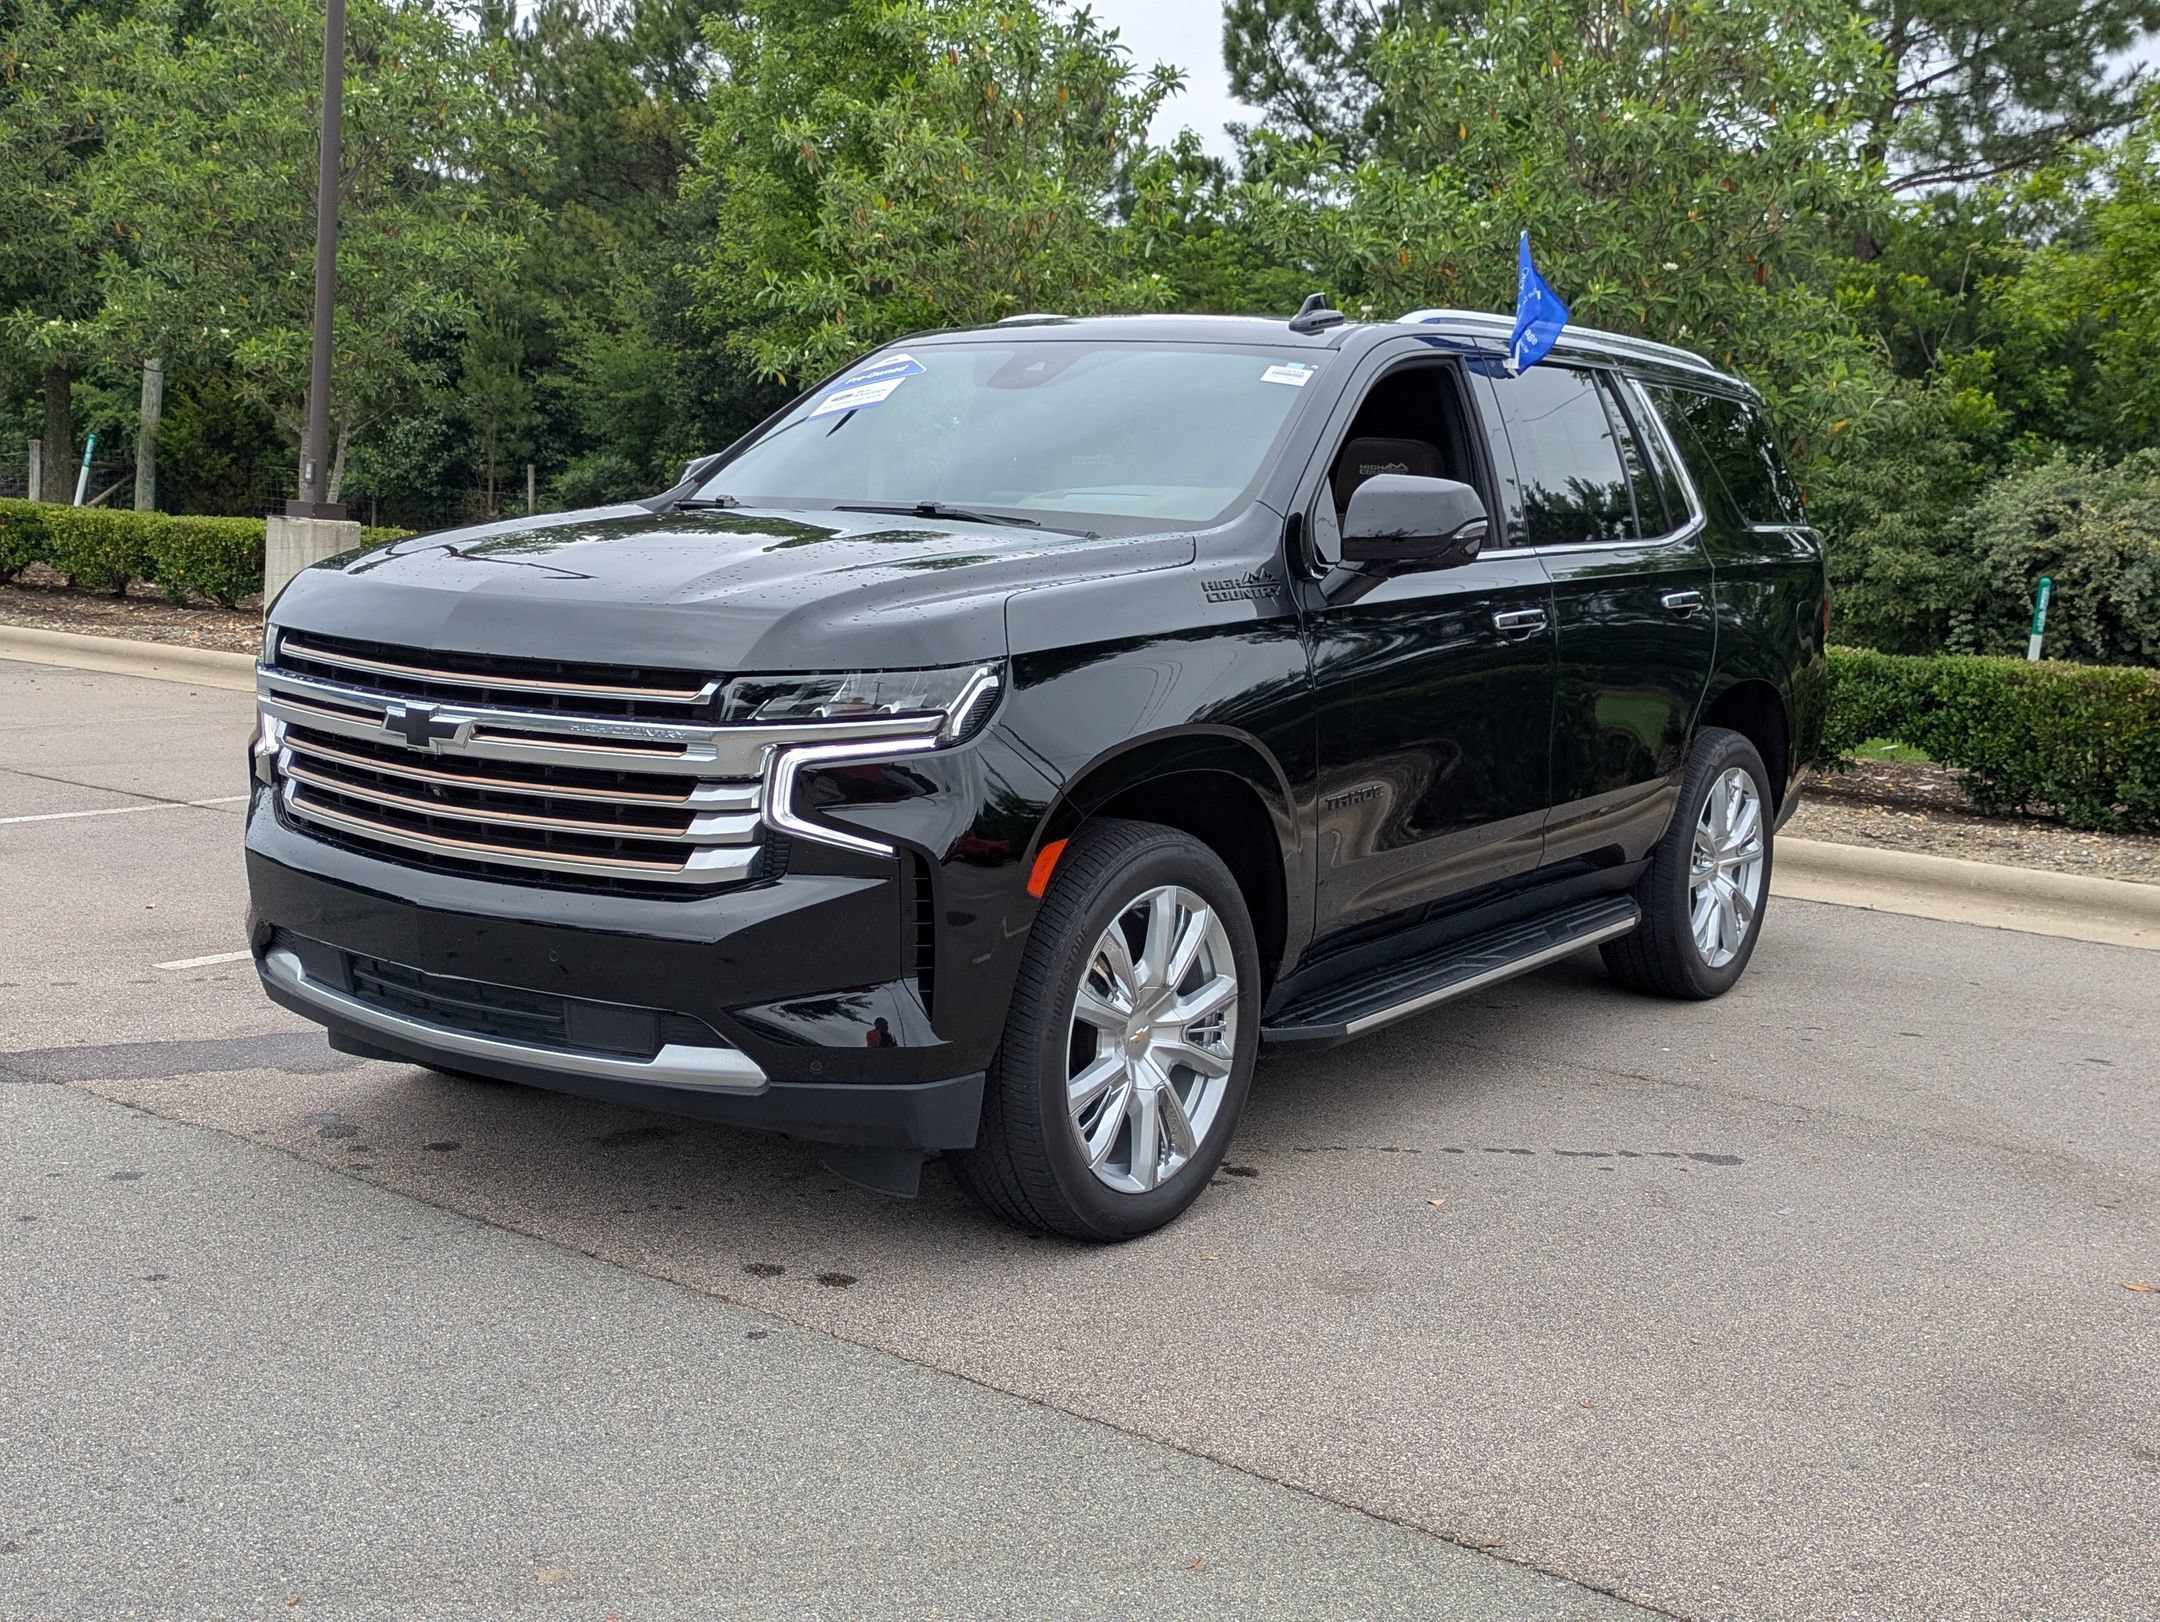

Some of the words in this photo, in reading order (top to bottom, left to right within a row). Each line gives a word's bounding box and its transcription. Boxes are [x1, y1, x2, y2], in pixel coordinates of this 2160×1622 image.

[1200, 578, 1242, 592] HIGH
[1205, 585, 1281, 604] COUNTRY
[611, 725, 688, 739] COUNTRY
[1045, 924, 1090, 1042] BRIDGESTONE
